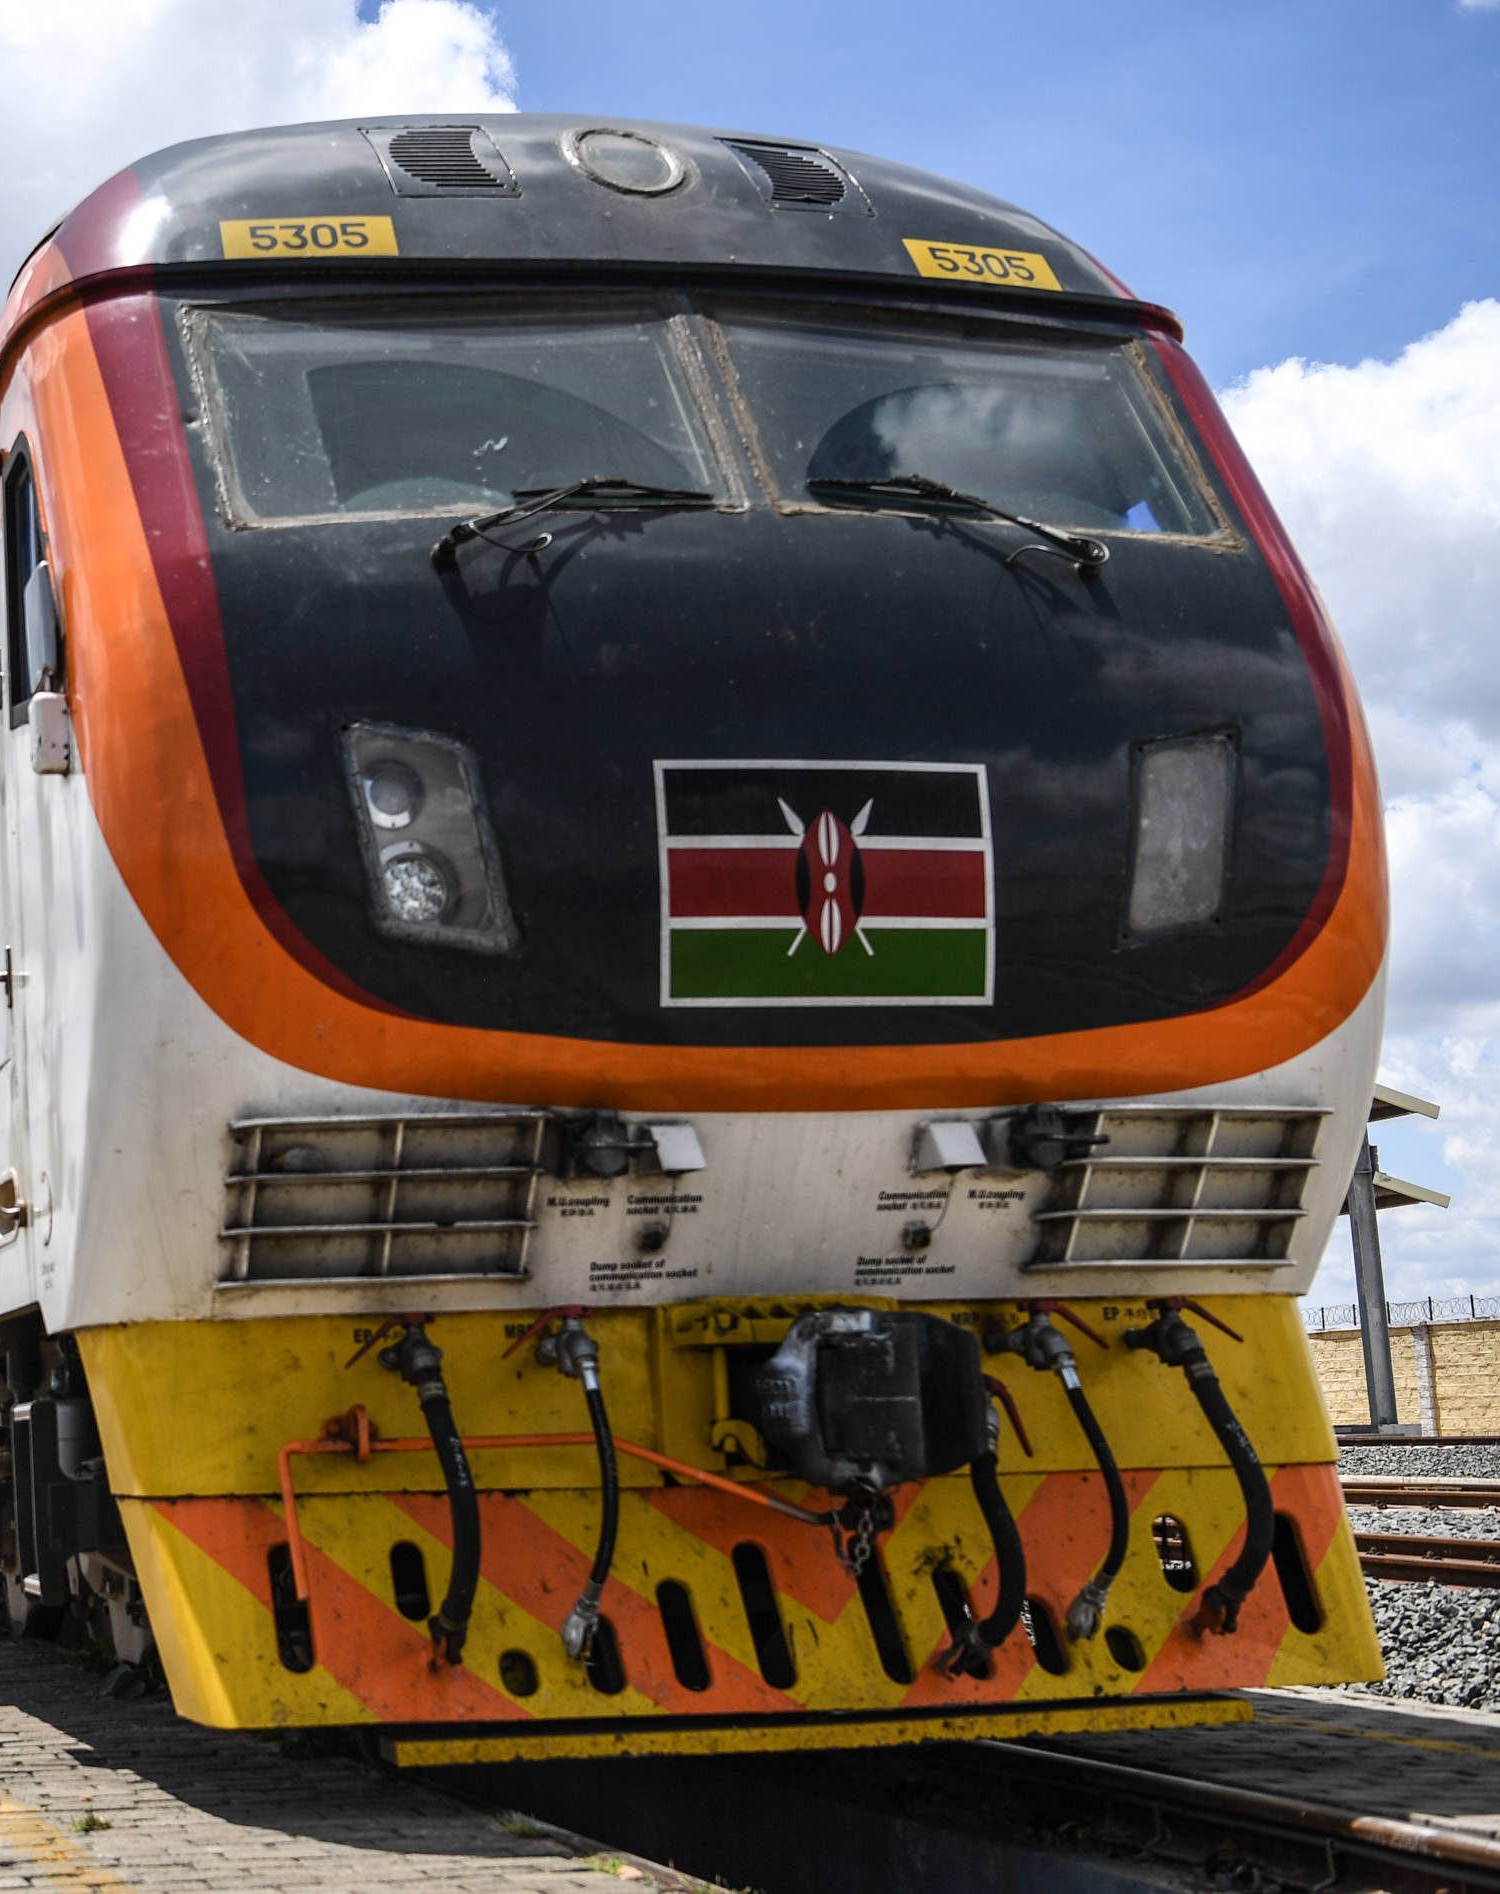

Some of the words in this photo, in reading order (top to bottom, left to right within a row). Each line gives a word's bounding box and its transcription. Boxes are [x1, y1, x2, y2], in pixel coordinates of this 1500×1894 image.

[249, 223, 369, 251] 5305
[928, 247, 1035, 281] 5305
[627, 1194, 703, 1204] Communication
[878, 1190, 949, 1200] Communication
[626, 1207, 659, 1215] socket
[877, 1202, 907, 1211] socket
[590, 1262, 617, 1271] Dump
[620, 1261, 652, 1269] socket
[655, 1259, 665, 1268] of
[589, 1271, 662, 1281] communication
[665, 1268, 697, 1278] socket
[1103, 1306, 1119, 1320] EP
